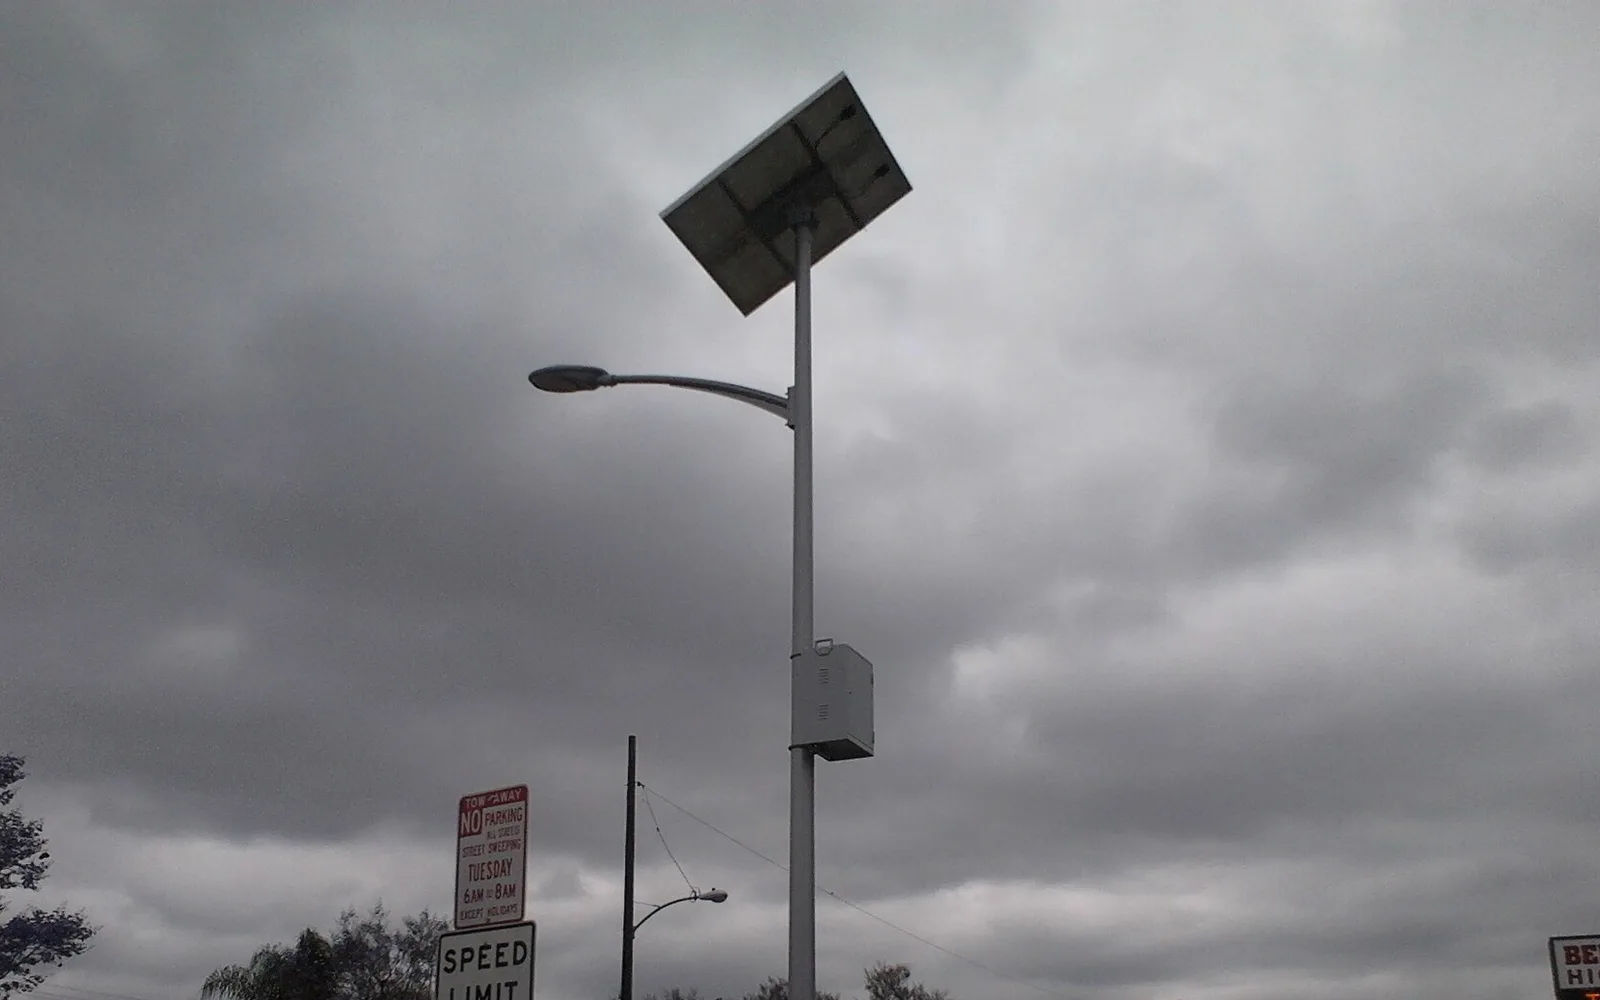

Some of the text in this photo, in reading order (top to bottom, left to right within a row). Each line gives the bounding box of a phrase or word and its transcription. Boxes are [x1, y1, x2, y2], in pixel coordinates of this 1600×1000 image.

[465, 796, 486, 809] TOW
[461, 807, 523, 836] NO PARKING
[462, 838, 521, 858] STREET SWEEPING
[468, 858, 513, 882] TUESDAY
[464, 888, 484, 904] 6AM
[495, 883, 516, 899] 8AM
[460, 903, 518, 921] EXCEPT HOLIDAYS
[443, 940, 527, 974] SPEED
[1563, 944, 1600, 965] BE
[1566, 968, 1600, 985] HI
